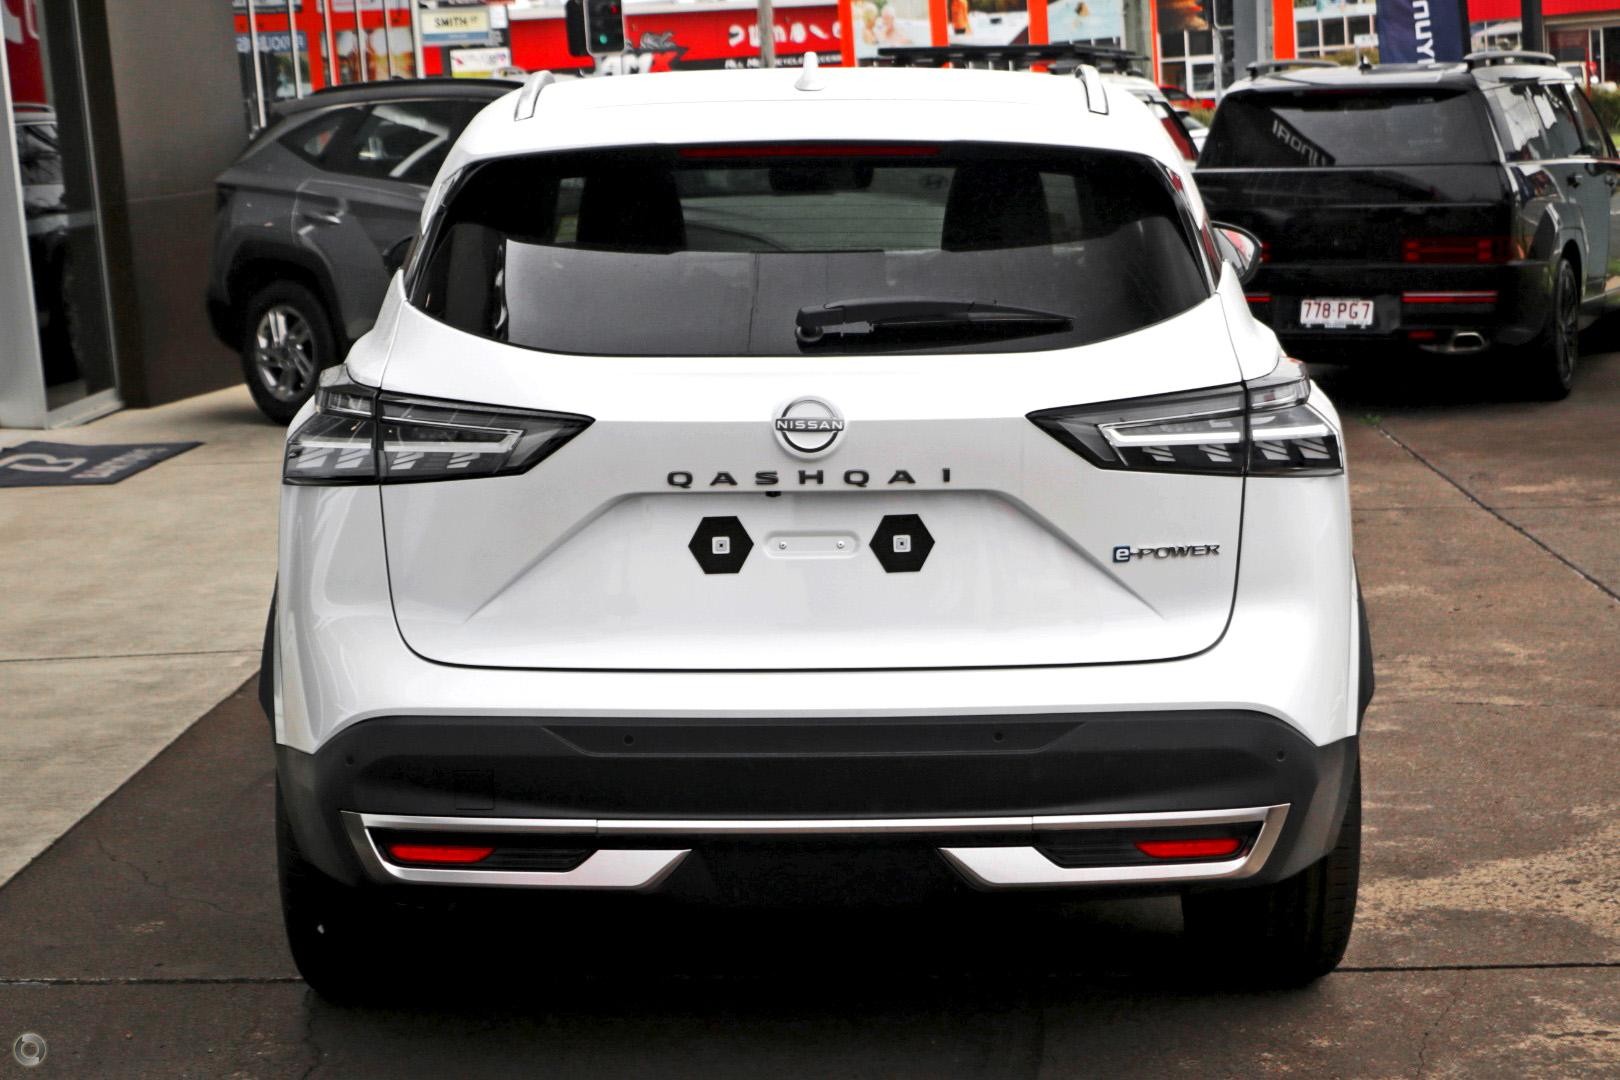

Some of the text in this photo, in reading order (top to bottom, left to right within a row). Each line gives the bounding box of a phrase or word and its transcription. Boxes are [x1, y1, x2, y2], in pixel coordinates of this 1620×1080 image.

[434, 16, 468, 27] SMITH
[1304, 302, 1370, 319] 778 PG7
[777, 420, 843, 430] NISSAN
[667, 467, 951, 488] QASHQAI
[1113, 545, 1220, 562] e-POWER
